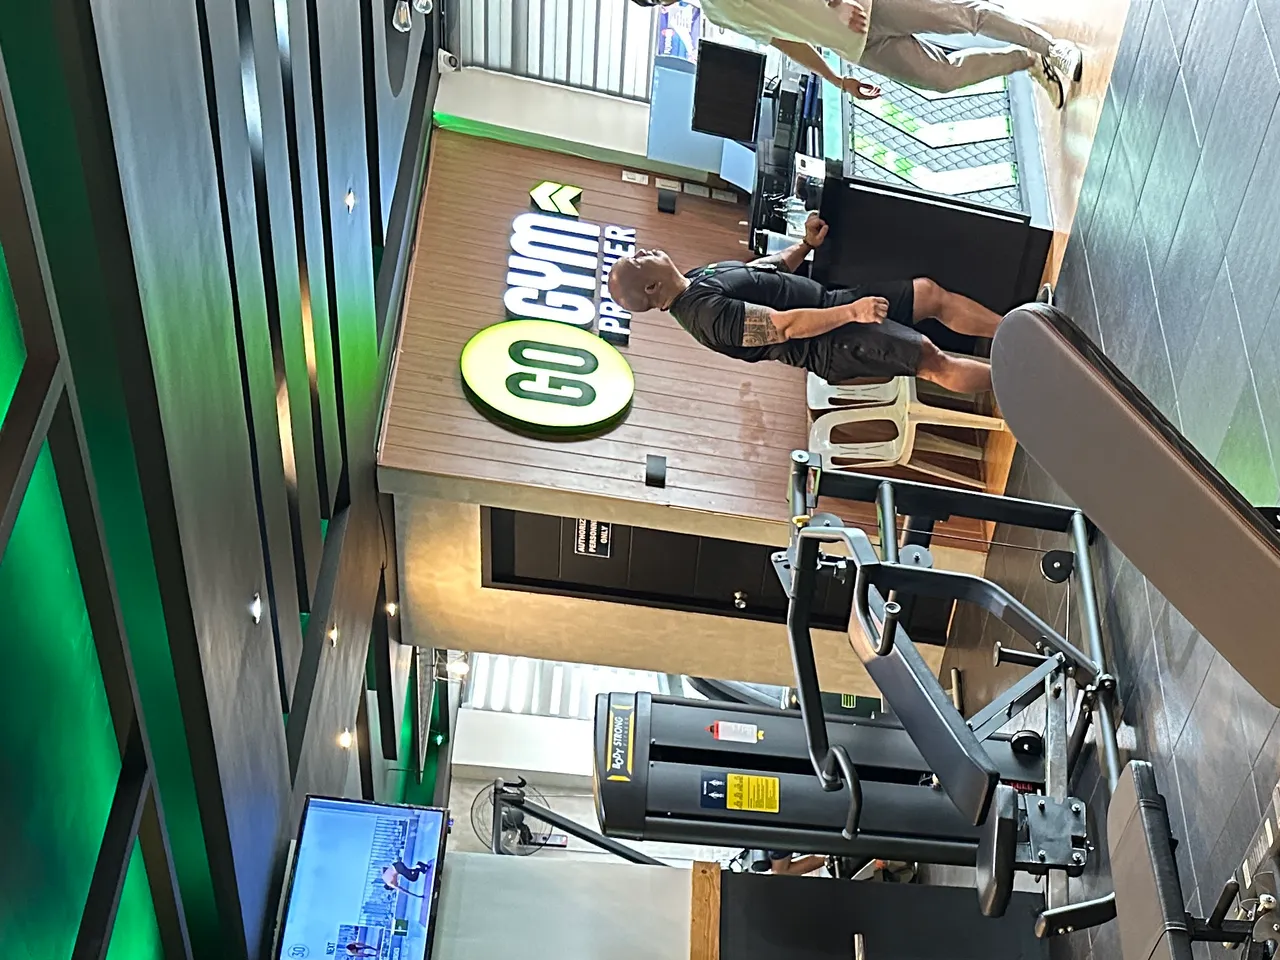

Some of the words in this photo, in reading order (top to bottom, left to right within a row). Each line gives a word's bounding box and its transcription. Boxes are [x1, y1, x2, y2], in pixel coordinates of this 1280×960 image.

[503, 212, 601, 325] GYM
[598, 225, 636, 335] PRIER
[505, 339, 599, 407] GO
[600, 525, 609, 544] ONLY
[613, 716, 624, 747] STRONG
[612, 747, 624, 769] BODY
[292, 947, 306, 958] 30
[326, 942, 336, 955] NEXT
